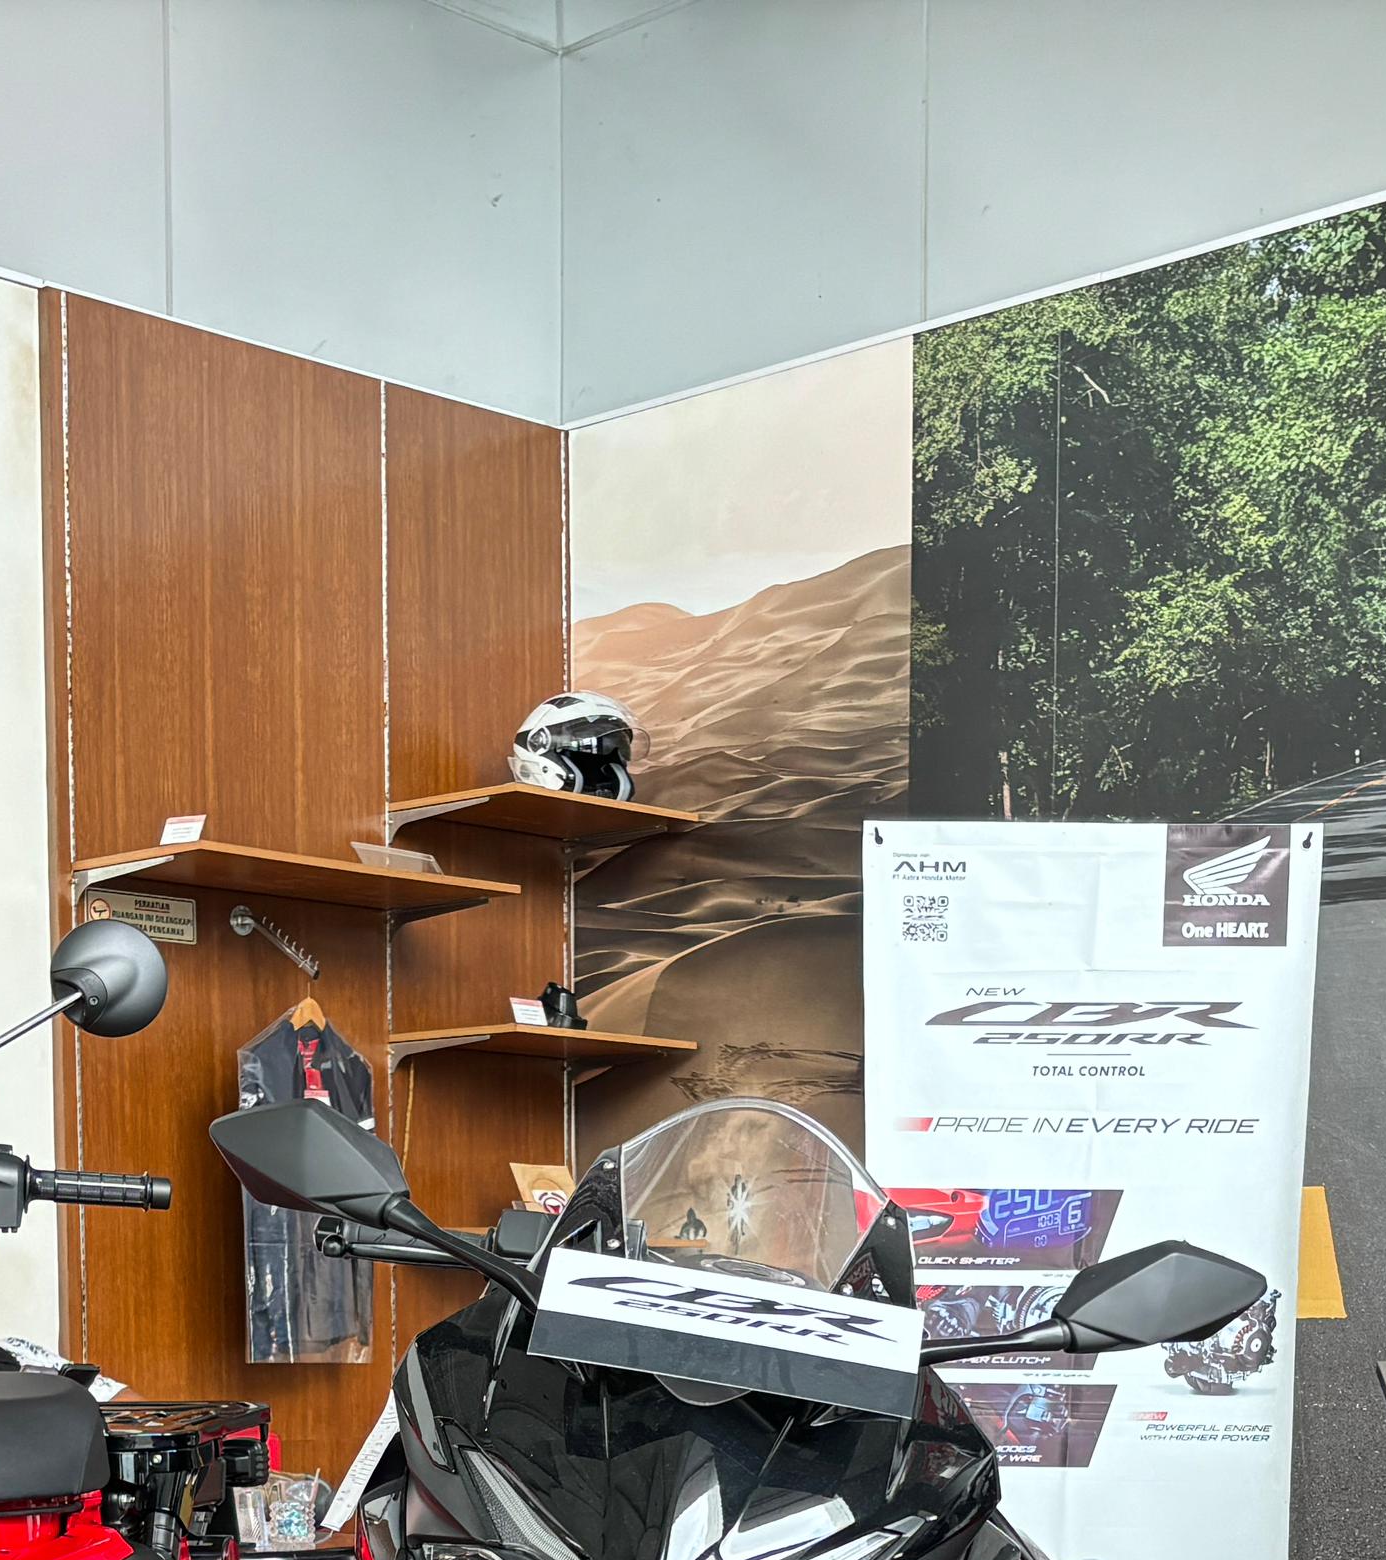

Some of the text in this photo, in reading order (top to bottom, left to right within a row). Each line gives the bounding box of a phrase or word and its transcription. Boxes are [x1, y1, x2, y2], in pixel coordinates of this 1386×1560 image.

[893, 860, 967, 873] AHM
[1181, 893, 1271, 906] HONDA
[1181, 921, 1214, 938] One
[966, 987, 1026, 997] NEW
[924, 1001, 1261, 1030] CBR
[973, 1032, 1213, 1047] 250RR
[1032, 1065, 1147, 1077] TOTAL CONTROL
[933, 1117, 1261, 1134] PRIDE IN EVERY RIDE
[1067, 1200, 1082, 1225] 6
[917, 1256, 959, 1265] QUICK
[567, 1276, 898, 1343] CBR
[613, 1298, 851, 1346] 250RR
[1146, 1423, 1273, 1432] POWERFUL ENGINE
[1168, 1434, 1219, 1442] HIGHER
[1221, 1434, 1270, 1442] POWER
[1009, 1455, 1043, 1463] WIRE
